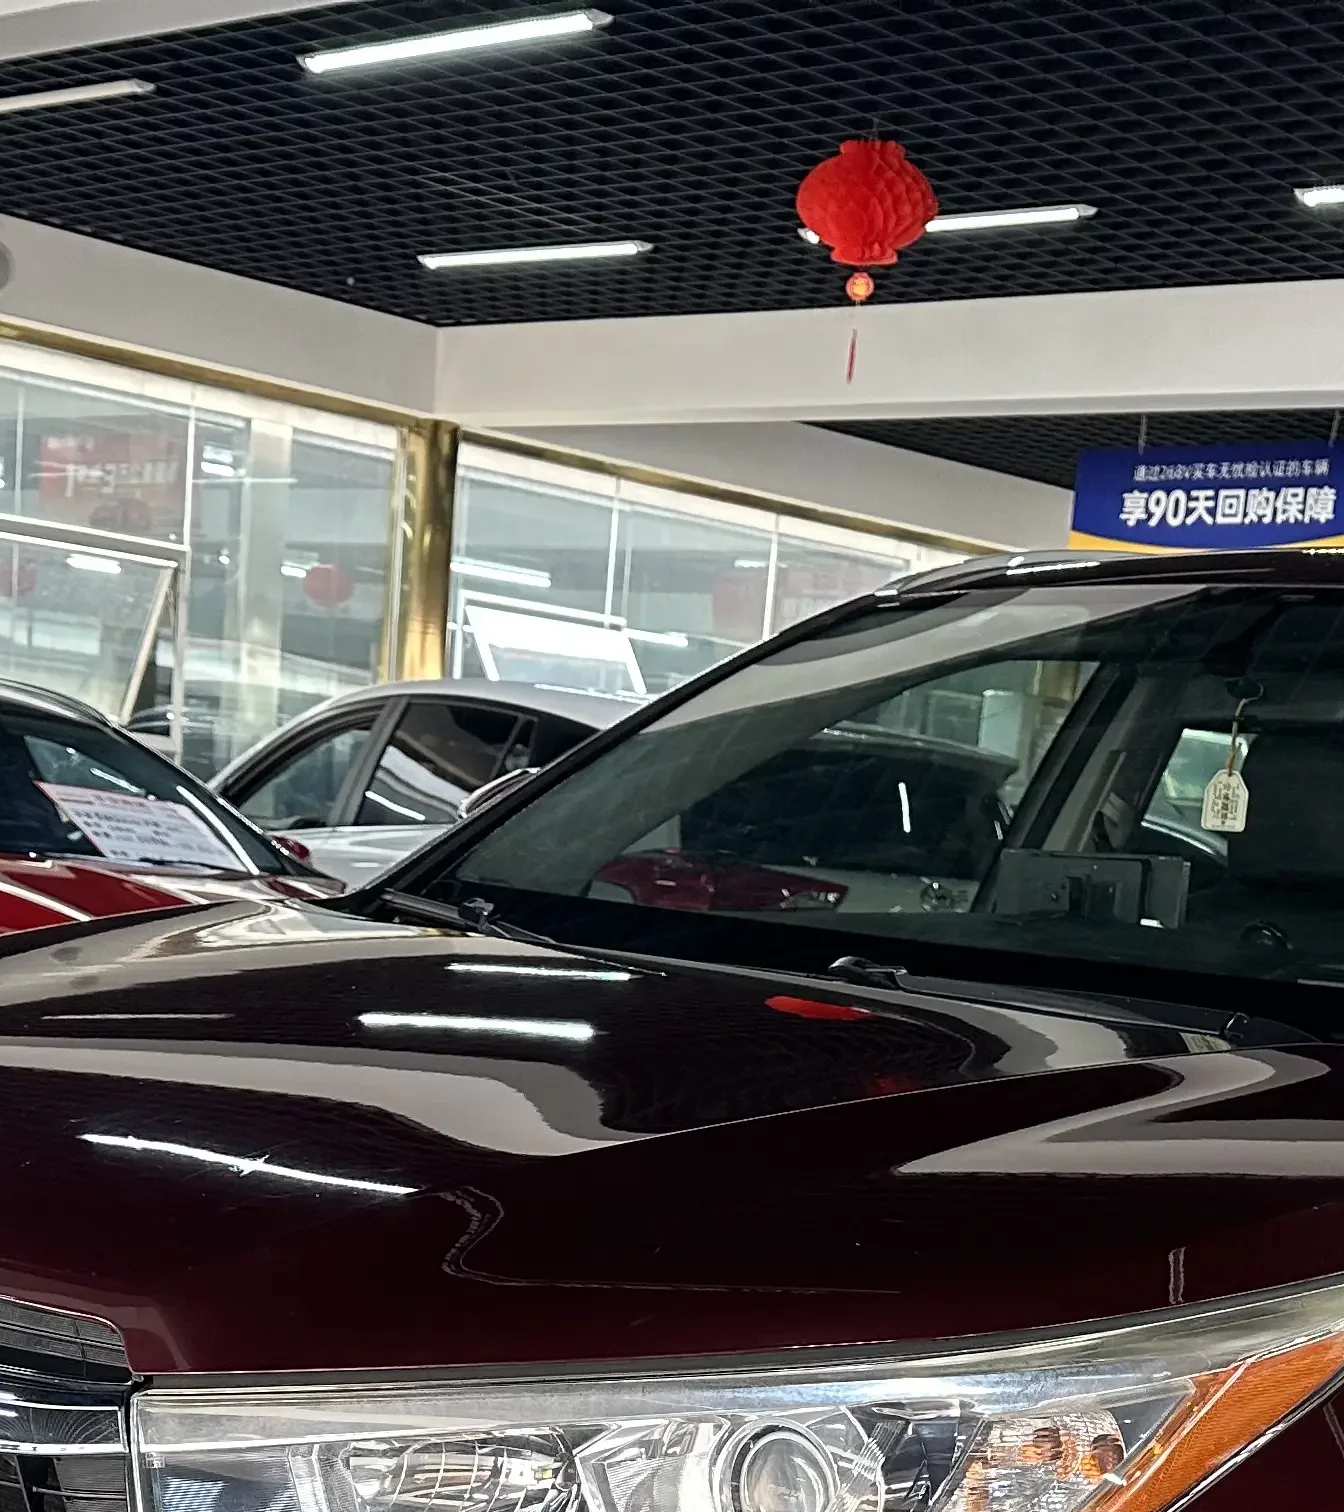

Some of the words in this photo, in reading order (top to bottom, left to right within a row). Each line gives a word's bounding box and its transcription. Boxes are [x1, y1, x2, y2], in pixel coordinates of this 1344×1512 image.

[1119, 486, 1337, 528] 享90天回购保障
